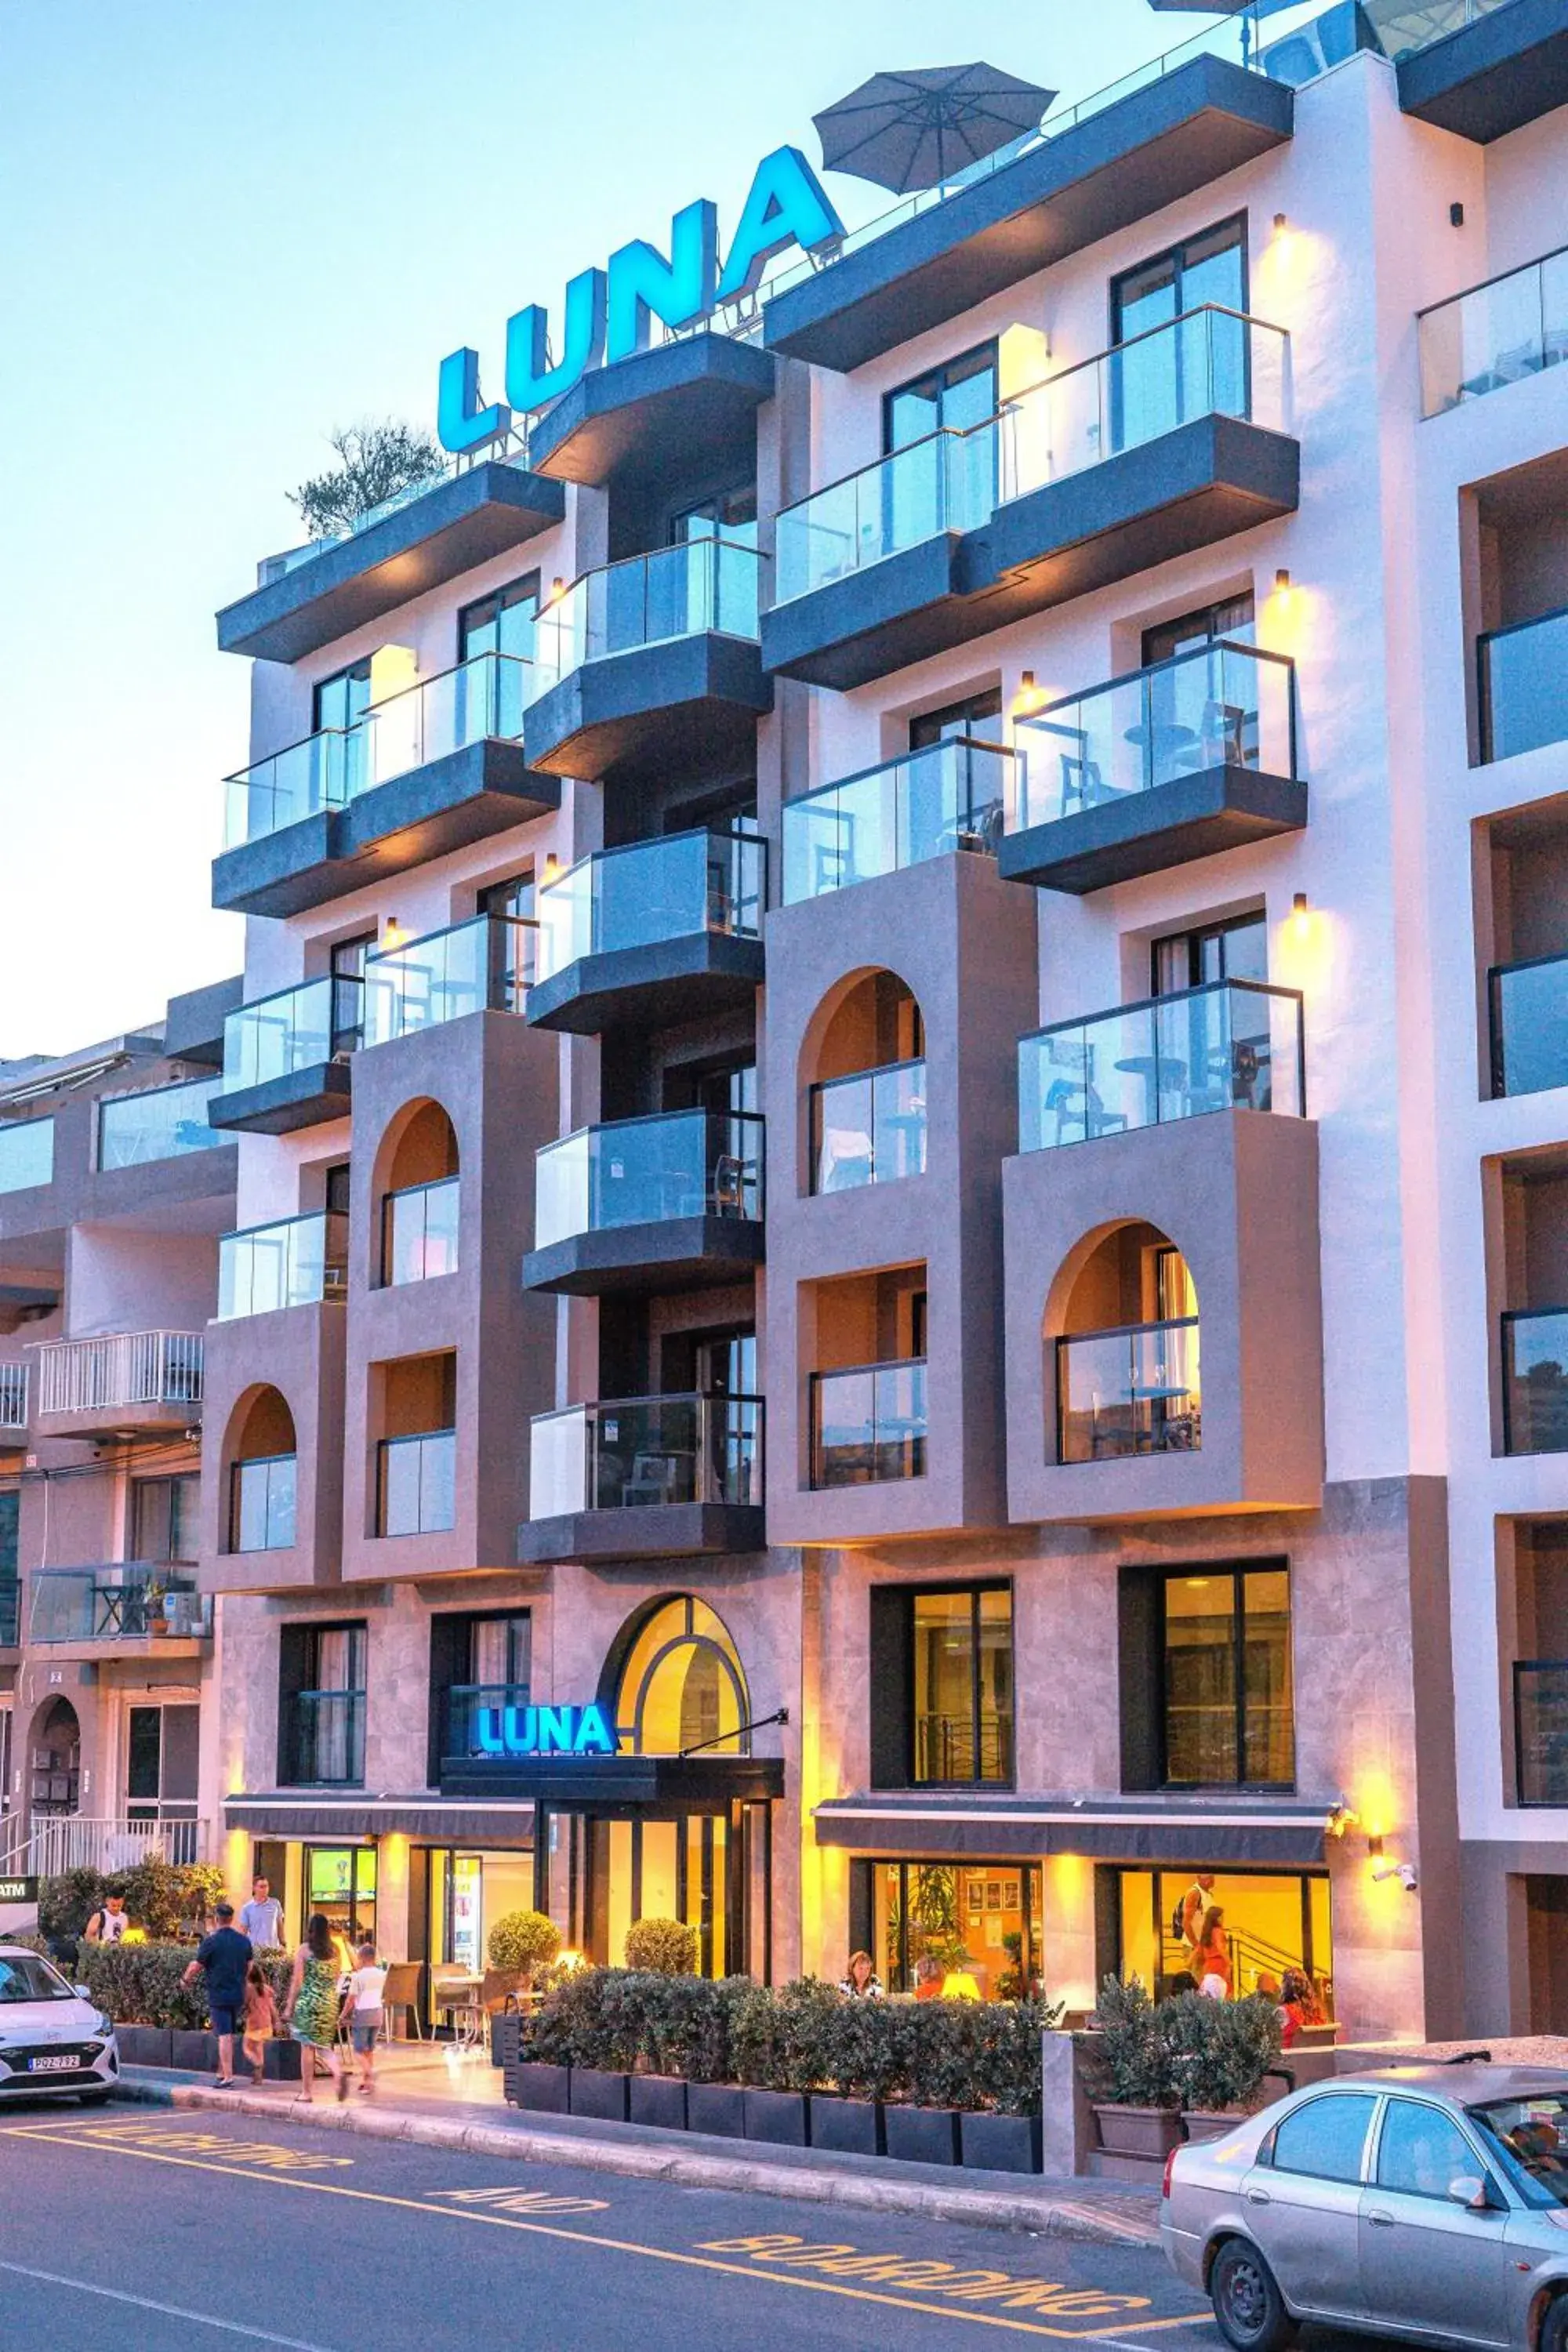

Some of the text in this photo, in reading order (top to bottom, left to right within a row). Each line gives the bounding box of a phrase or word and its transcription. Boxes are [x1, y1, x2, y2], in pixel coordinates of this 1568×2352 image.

[437, 143, 848, 455] LUNA
[477, 1704, 617, 1752] LUNA
[423, 2187, 610, 2214] AND
[693, 2234, 1152, 2316] BOARDING
